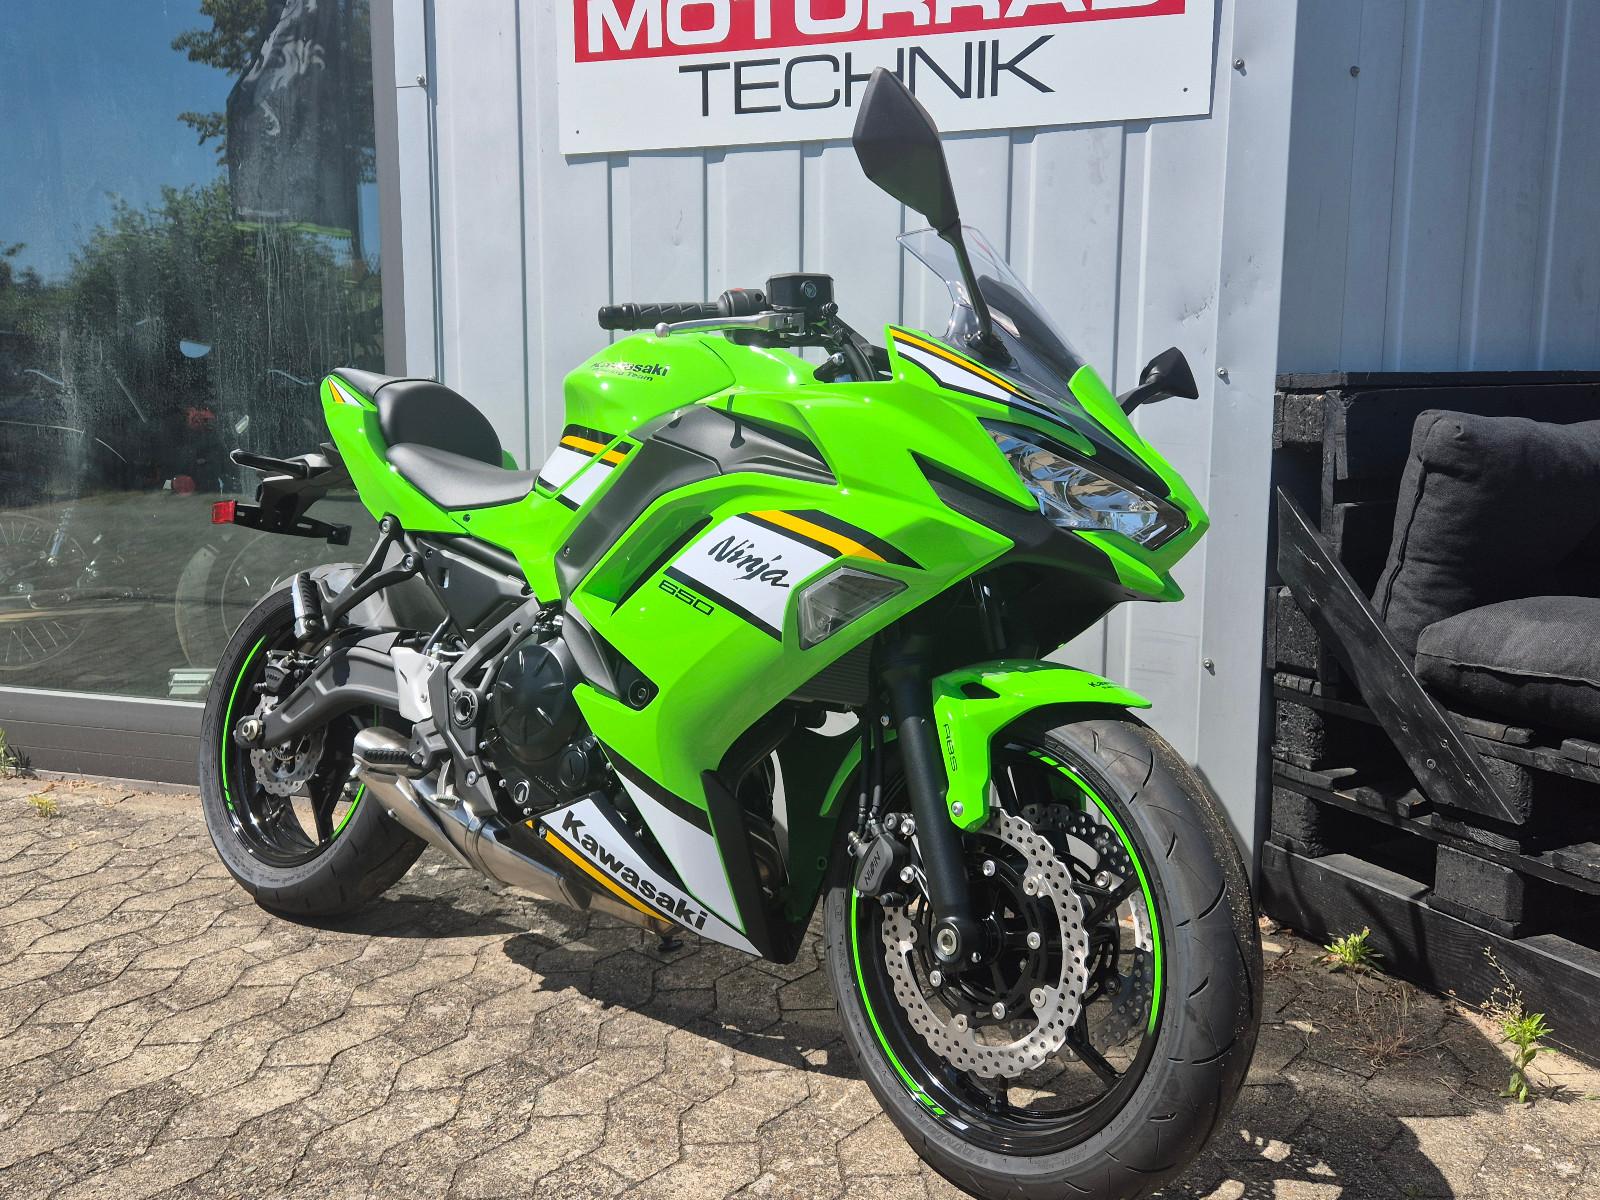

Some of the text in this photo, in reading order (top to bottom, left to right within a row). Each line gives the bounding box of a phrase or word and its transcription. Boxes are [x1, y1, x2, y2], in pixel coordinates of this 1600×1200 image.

[587, 0, 1158, 54] MOTOR
[679, 34, 1056, 117] TECHNIK
[708, 535, 790, 588] Ninja
[658, 579, 715, 616] 650
[943, 723, 958, 772] ABS
[561, 809, 709, 931] Kawasaki
